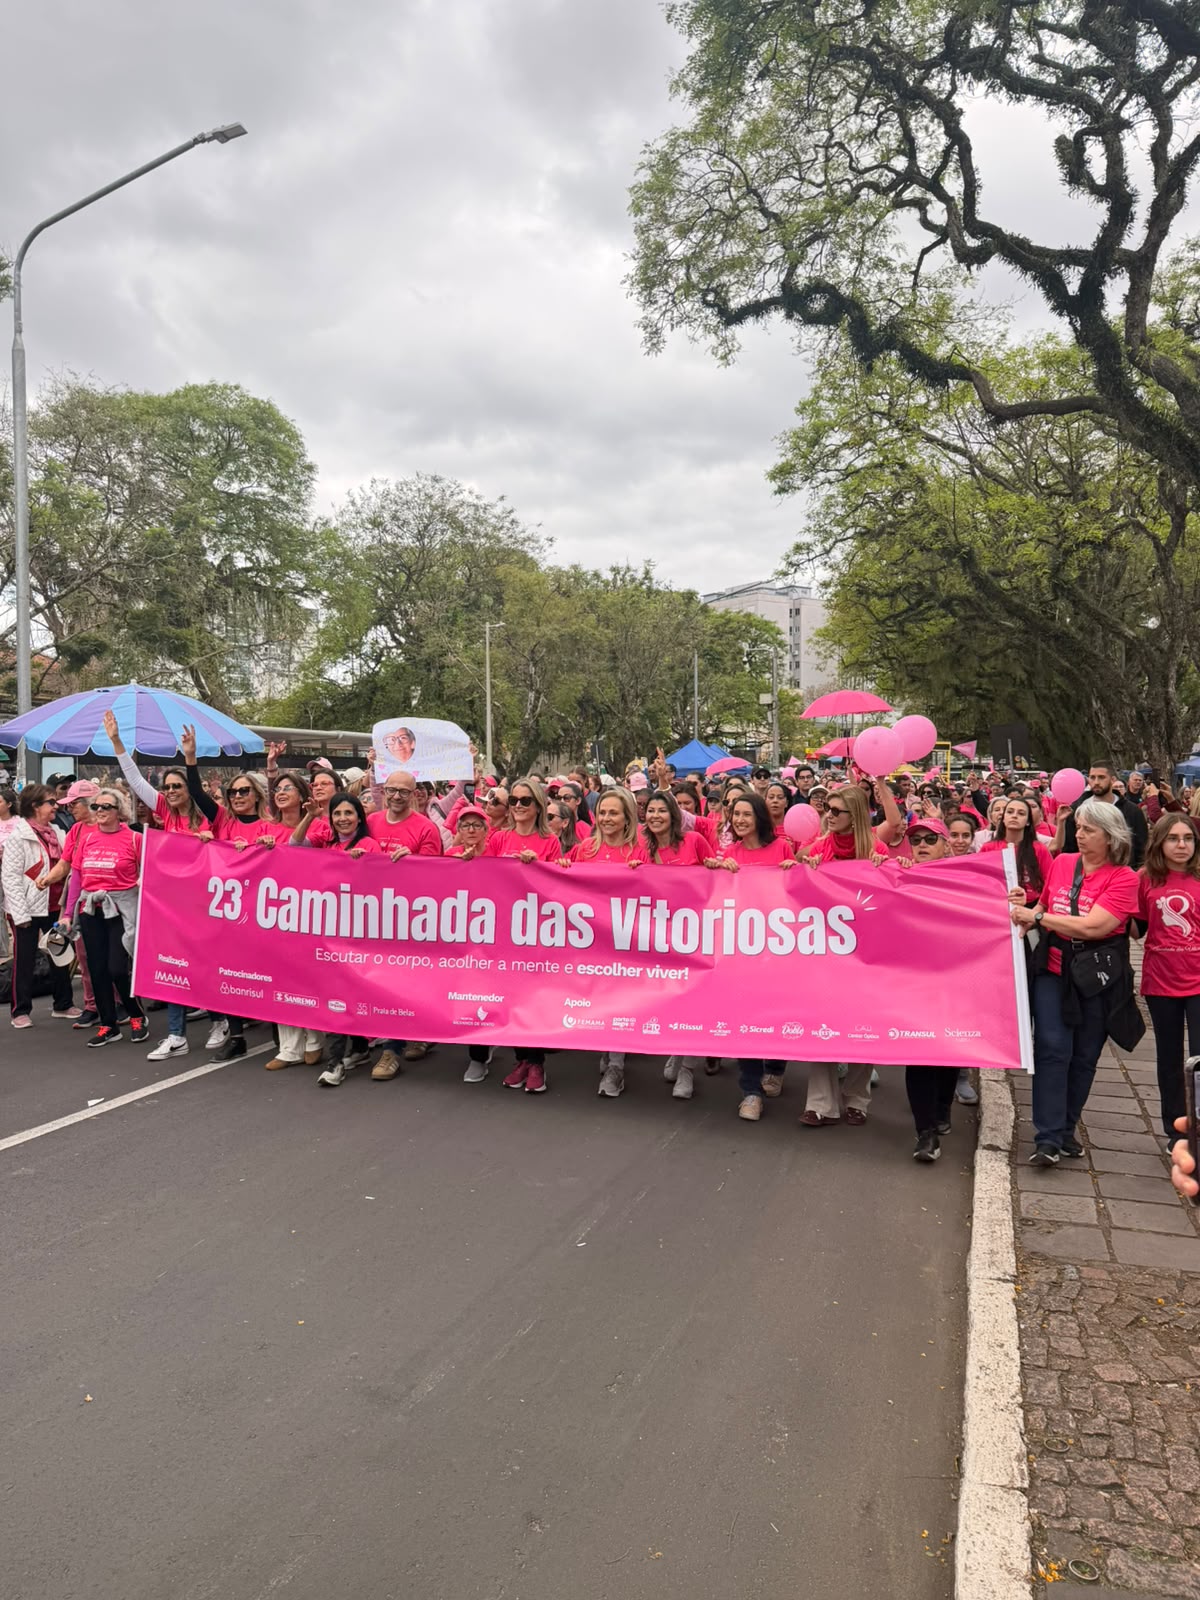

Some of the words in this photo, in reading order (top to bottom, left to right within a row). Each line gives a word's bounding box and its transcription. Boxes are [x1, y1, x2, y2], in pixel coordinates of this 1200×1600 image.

[256, 877, 497, 945] Caminhada
[510, 892, 595, 949] das
[610, 896, 857, 956] Vitoriosas
[158, 953, 190, 968] Realização
[315, 948, 370, 964] Escutar
[373, 954, 383, 965] o
[387, 953, 434, 970] corpo,
[438, 955, 493, 970] acolher
[497, 960, 507, 971] a
[511, 959, 560, 973] mente
[564, 963, 574, 974] e
[576, 962, 643, 978] escolher
[646, 965, 690, 981] viver!
[154, 970, 191, 987] IMAMA
[218, 966, 273, 983] Patrocinadores
[229, 984, 264, 999] banrisul
[447, 991, 505, 1003] Mantenedor
[283, 993, 317, 1008] SANREMO
[563, 997, 592, 1009] Apoio
[372, 1006, 389, 1015] Praia
[389, 1008, 398, 1016] de
[398, 1008, 416, 1017] Belas
[577, 1018, 605, 1027] FEMAMA
[749, 1025, 775, 1034] Sicredi
[899, 1030, 936, 1039] TRANSUL
[944, 1027, 982, 1038] Scienza
